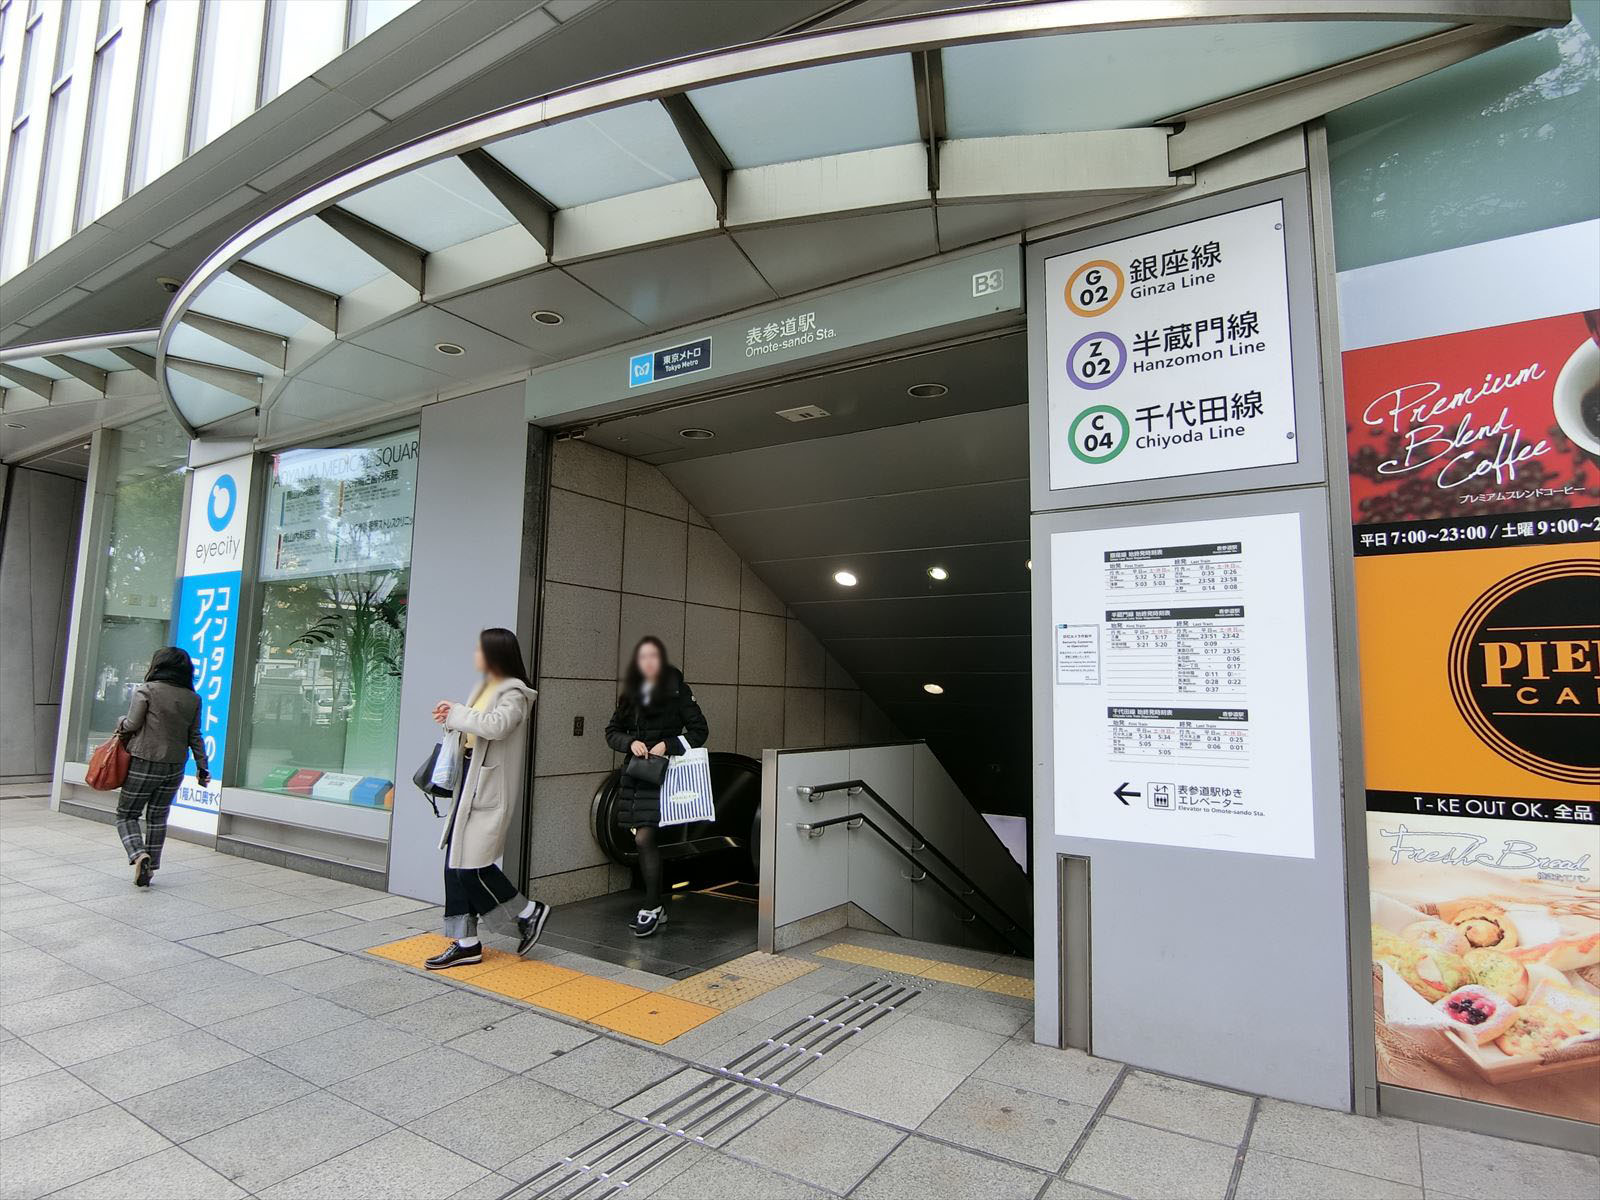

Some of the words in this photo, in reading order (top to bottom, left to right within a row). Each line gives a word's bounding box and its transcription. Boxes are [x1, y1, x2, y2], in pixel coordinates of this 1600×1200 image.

[1129, 241, 1222, 285] 銀座線
[973, 270, 1003, 297] B3
[1085, 269, 1102, 286] G
[1130, 281, 1176, 300] Ginza
[1181, 271, 1216, 289] Line
[1080, 285, 1109, 306] 02
[746, 312, 816, 346] 表参道駅
[816, 328, 837, 341] Sta.
[1132, 310, 1260, 357] 半蔵門線
[663, 347, 701, 366] 東京メトロ
[1089, 341, 1103, 358] Z
[1133, 350, 1223, 374] Hanzomon
[1229, 340, 1266, 357] Line
[665, 364, 682, 372] Tokyo
[681, 359, 699, 369] Metro
[1081, 358, 1111, 378] 02
[1363, 363, 1547, 433] Premium
[1091, 415, 1105, 431] C
[1134, 390, 1264, 433] 千代田線
[1083, 432, 1114, 452] 04
[1136, 430, 1204, 449] Chiyoda
[1209, 424, 1246, 440] Line
[1377, 408, 1514, 475] Blend
[376, 441, 419, 467] SQUAR
[1437, 428, 1551, 489] Coffee
[1459, 486, 1586, 505] プレミアムブレンドコーヒー
[1360, 533, 1388, 548] 平日
[1501, 521, 1535, 538] 土曜
[196, 536, 240, 564] eyecity
[204, 587, 231, 763] コンタクトの
[1516, 686, 1600, 706] CA
[1178, 785, 1243, 799] 表参道駅ゆき
[1178, 796, 1244, 808] エレベーター
[1465, 799, 1506, 816] OUT
[1511, 801, 1549, 819] OK.
[1553, 803, 1593, 821] 全品
[1380, 823, 1488, 866] Fresh
[1475, 839, 1591, 870] Bread
